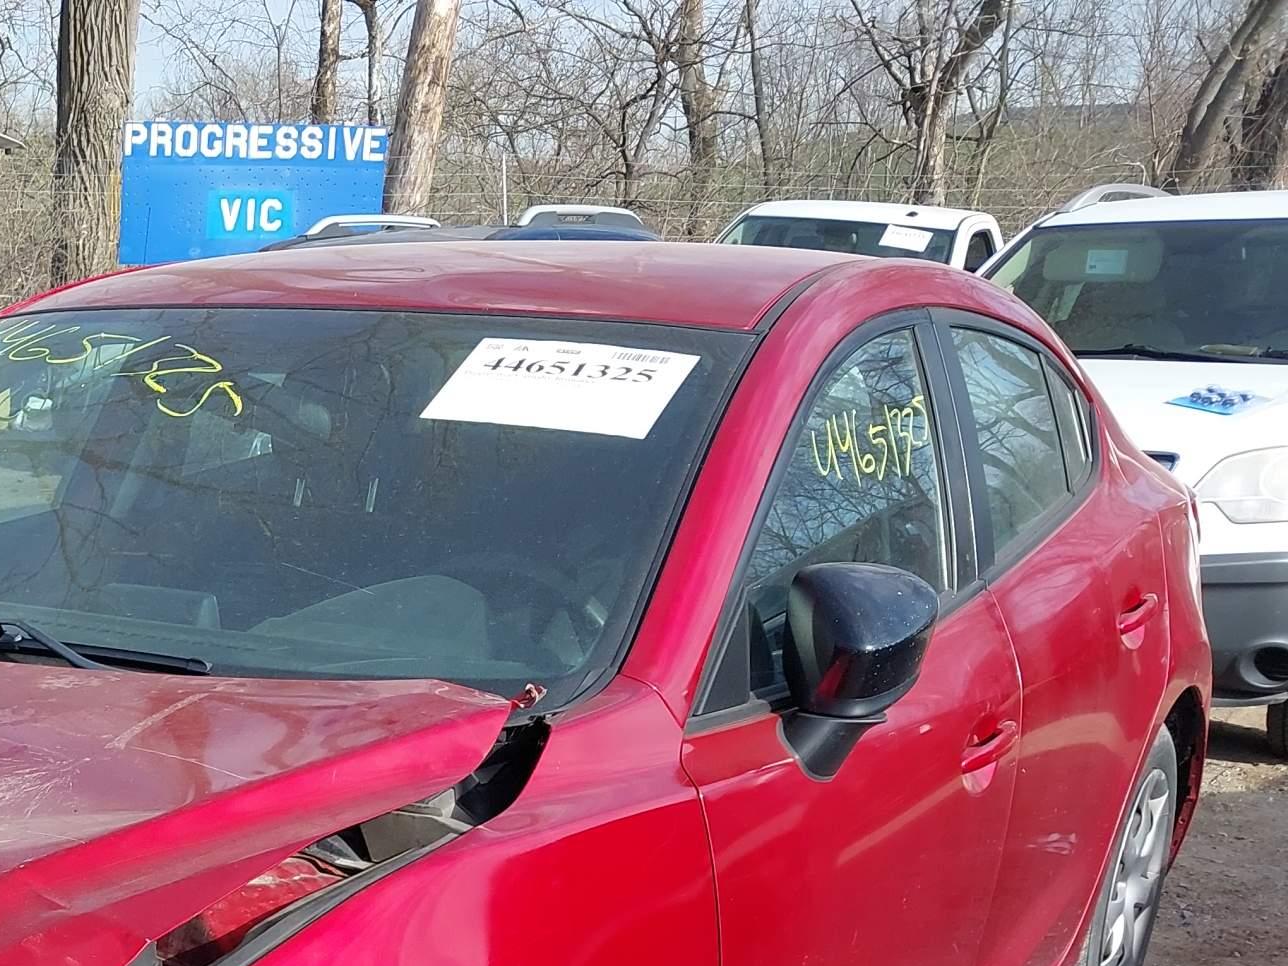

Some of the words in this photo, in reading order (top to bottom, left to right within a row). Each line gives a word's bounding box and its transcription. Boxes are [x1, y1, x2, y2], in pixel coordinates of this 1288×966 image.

[125, 123, 386, 162] PROGRESSIVE
[220, 197, 283, 232] VIC
[483, 356, 658, 383] 44651325
